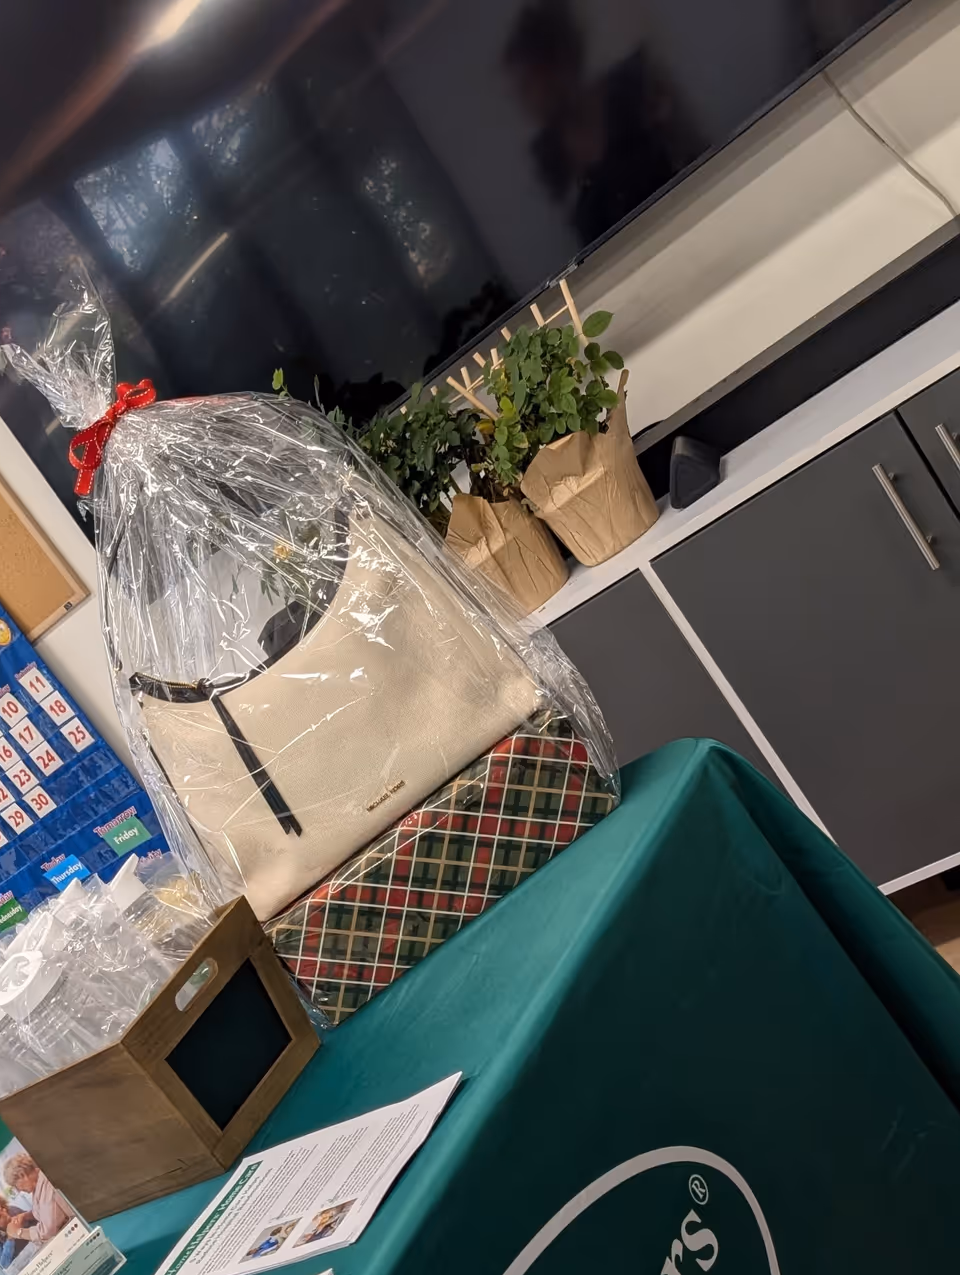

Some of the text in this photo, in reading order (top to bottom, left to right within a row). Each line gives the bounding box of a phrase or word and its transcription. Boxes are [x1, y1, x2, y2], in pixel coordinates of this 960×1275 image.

[1, 701, 19, 718] 10
[29, 676, 46, 693] 11
[18, 726, 35, 744] 17
[49, 700, 67, 716] 18
[13, 769, 31, 787] 23
[36, 750, 55, 769] 24
[68, 726, 86, 744] 25
[8, 810, 26, 827] 29
[32, 793, 49, 810] 30
[93, 806, 136, 837] Tomorrow
[113, 827, 139, 845] Friday
[41, 854, 65, 872] Today
[51, 861, 83, 885] Thursday
